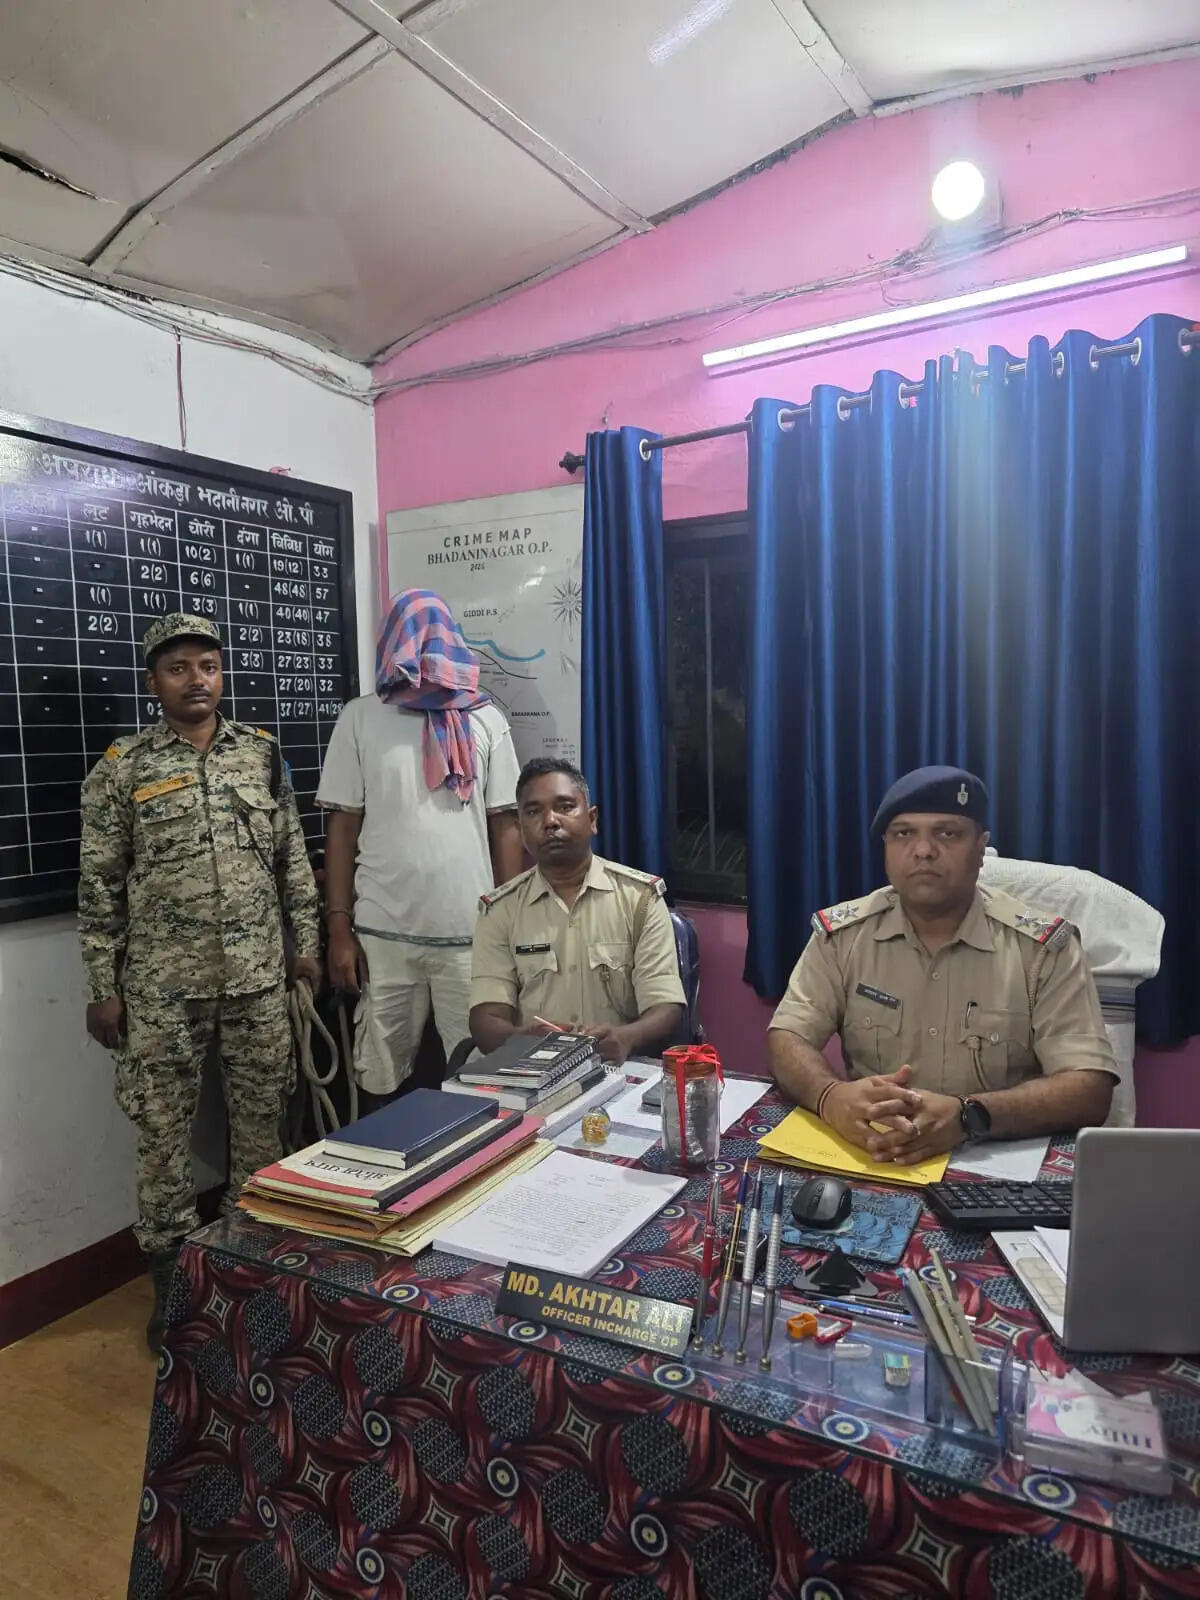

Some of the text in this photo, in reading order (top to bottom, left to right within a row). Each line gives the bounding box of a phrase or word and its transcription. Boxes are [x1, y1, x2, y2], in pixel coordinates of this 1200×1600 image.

[197, 486, 269, 519] भदानीनगर
[85, 529, 328, 578] 1(1) 1(1) 10(2) 1(1) 19(12) 33
[188, 519, 215, 538] चोरी
[237, 527, 260, 546] दंगा
[313, 541, 334, 558] योग
[427, 541, 553, 566] BHADANINAGAR O.P.
[443, 527, 532, 548] CRIME MAP
[141, 564, 168, 584] 2(2)
[190, 571, 216, 590] 6(6)
[315, 587, 329, 600] 57
[90, 586, 330, 624] 1(1) 1(1) 3(3) 1(1) 40(40) 47
[463, 609, 485, 618] GIDDI
[88, 613, 119, 635] 2(2)
[239, 626, 263, 644] 2(2)
[240, 651, 334, 671] 3(3) 27(23) 33
[279, 676, 334, 693] 27(20) 32
[280, 701, 314, 718] 37(27)
[506, 1271, 545, 1298] MD.
[548, 1282, 641, 1323] AKHTAR
[541, 1305, 680, 1348] OFFICER INCHARGE OP
